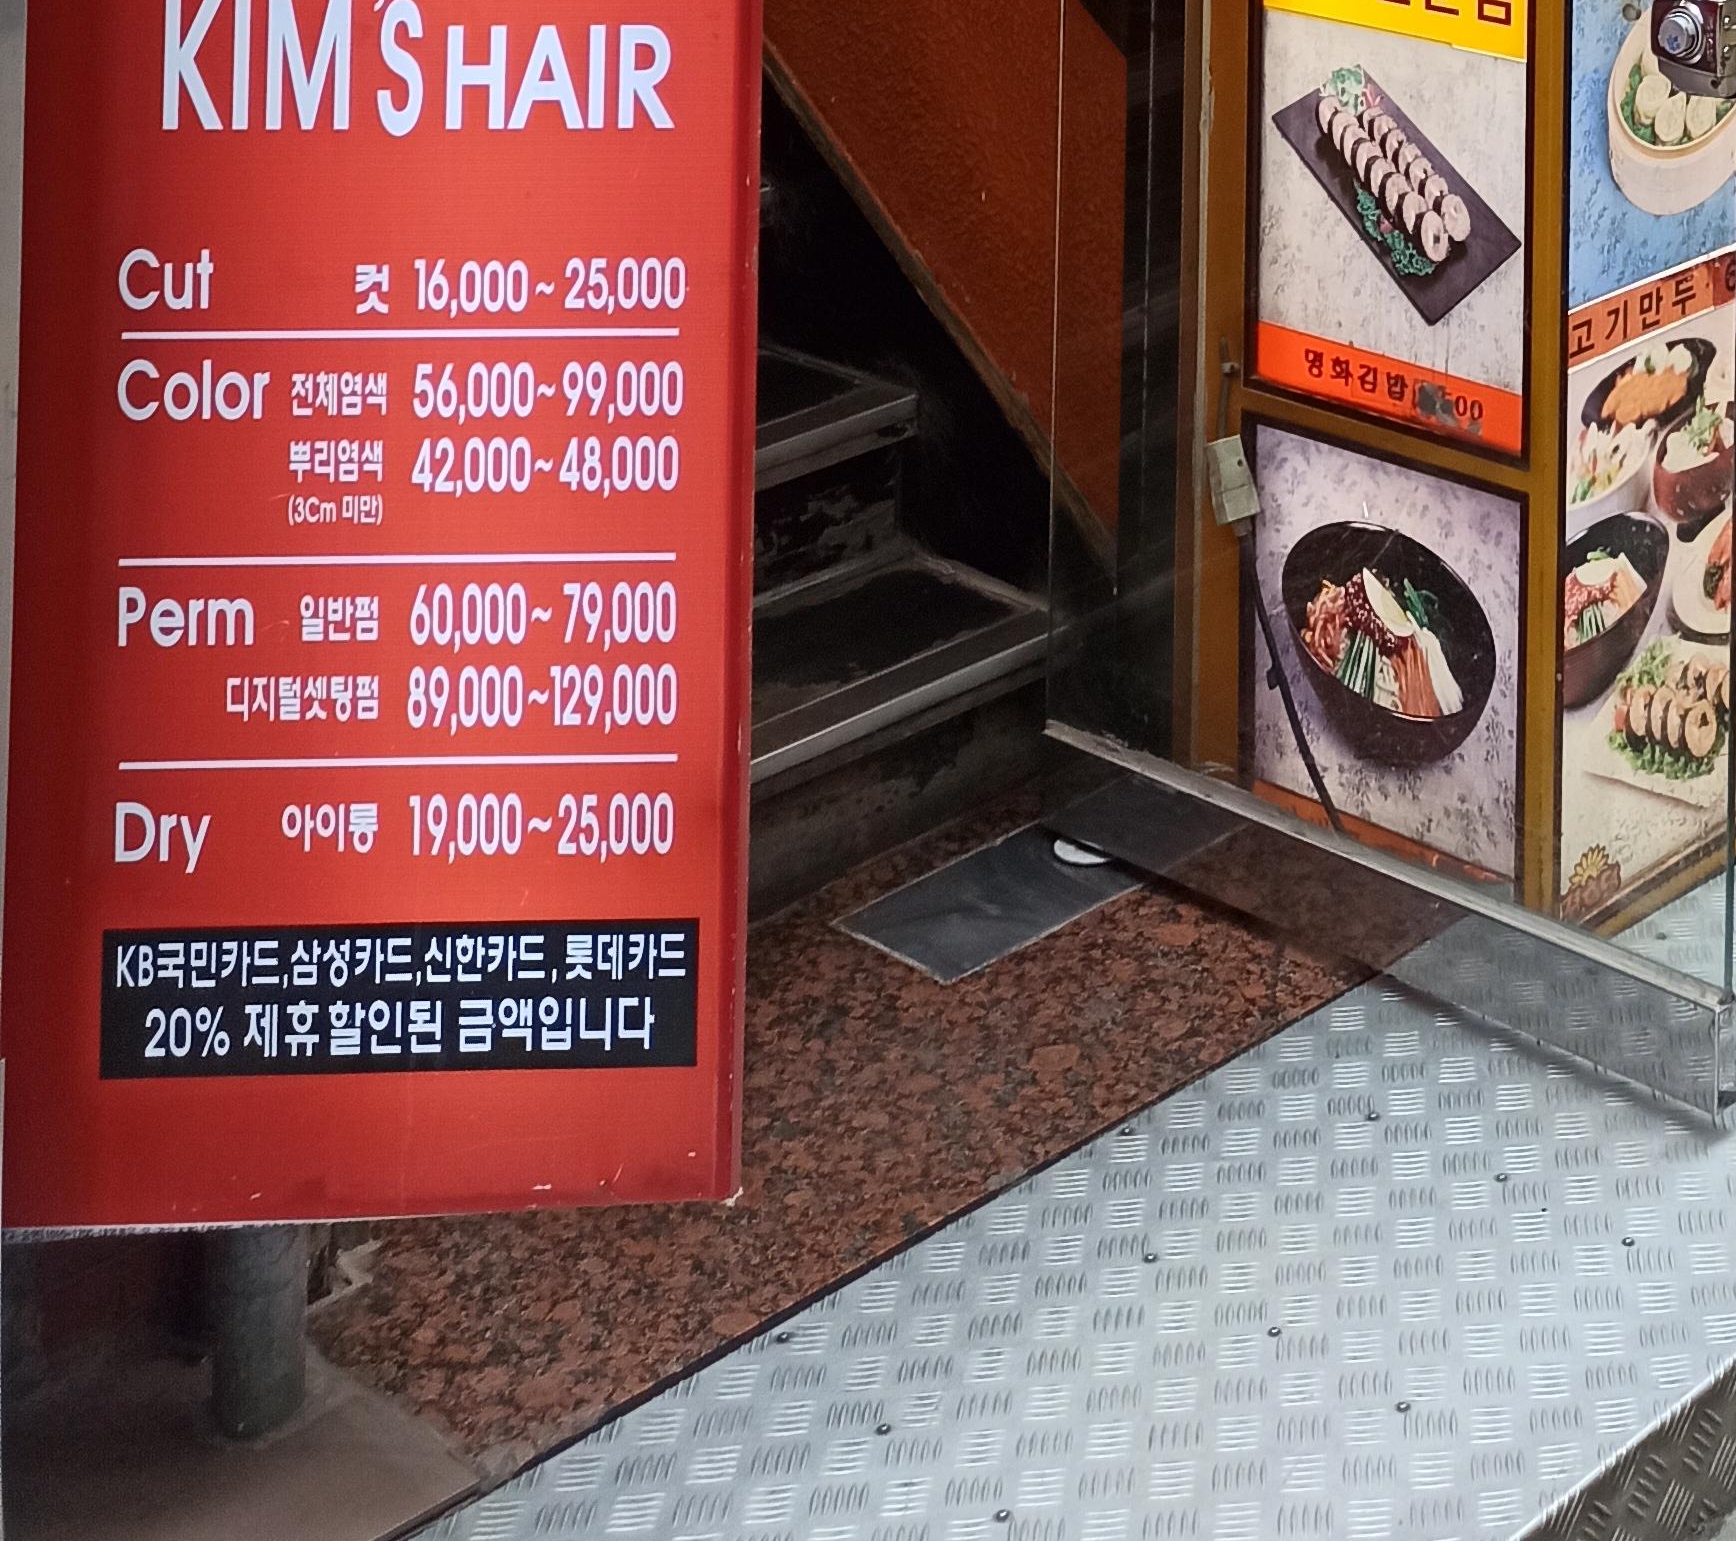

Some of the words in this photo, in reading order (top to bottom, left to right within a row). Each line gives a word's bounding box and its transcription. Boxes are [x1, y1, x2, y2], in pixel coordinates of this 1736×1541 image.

[445, 25, 675, 130] HAIR
[118, 249, 213, 311] Cut
[354, 264, 390, 315] 컷
[1571, 279, 1698, 357] 고기만두
[117, 359, 270, 420] Color
[290, 372, 388, 417] 전체염색
[1305, 348, 1409, 401] 명화김밥
[289, 439, 384, 483] 뿌리염색
[117, 586, 255, 648] Perm
[300, 594, 380, 642] 일반펌
[226, 674, 380, 723] 디지털셋팅펌
[114, 801, 211, 874] Dry
[281, 802, 379, 854] 아이롱
[144, 1003, 231, 1059] 20%
[458, 996, 656, 1053] 금액입니다
